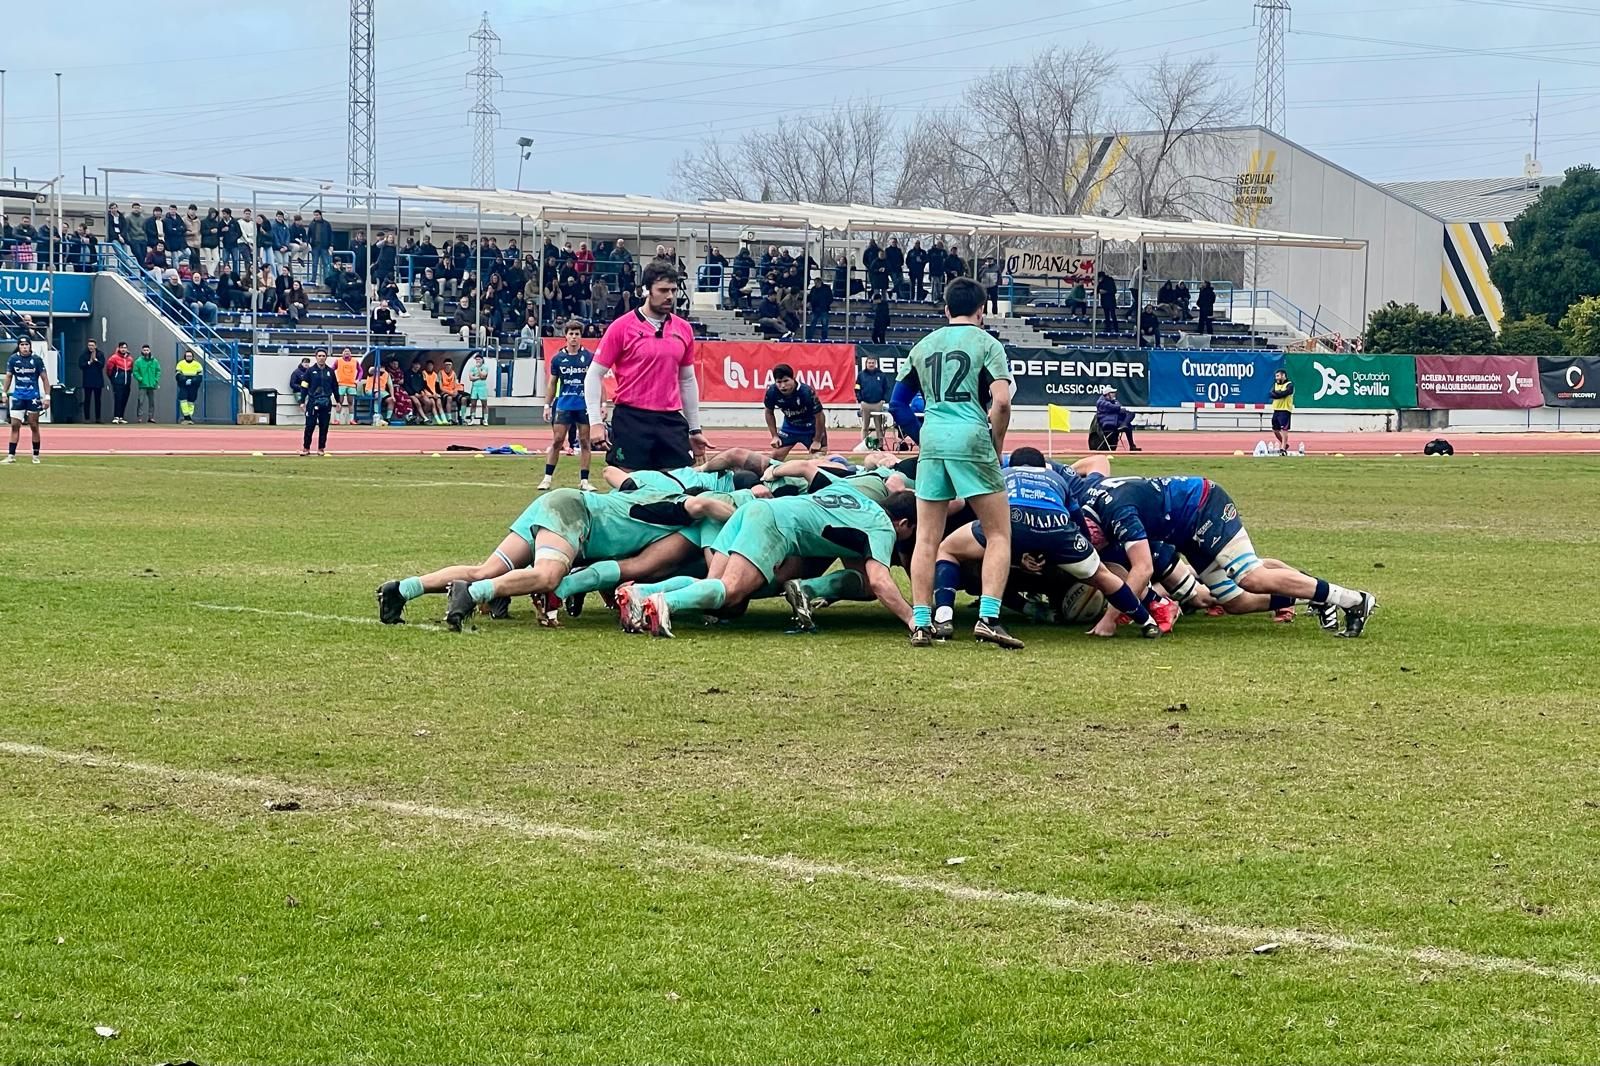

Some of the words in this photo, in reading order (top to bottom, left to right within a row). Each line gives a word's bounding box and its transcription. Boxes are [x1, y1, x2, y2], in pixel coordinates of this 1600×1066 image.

[1022, 253, 1080, 274] PIRAÑAS
[0, 276, 54, 293] TUJA
[925, 350, 971, 402] 12
[1010, 360, 1144, 377] DEFENDER
[1181, 357, 1255, 380] Cruzcampo
[1352, 371, 1390, 382] Diputación
[753, 369, 834, 390] LAANA
[1421, 374, 1446, 382] ACELERA
[1446, 374, 1455, 382] TU
[1455, 373, 1501, 382] RECUPERACIÓN
[1045, 384, 1084, 394] CLASSIC
[1353, 382, 1390, 396] Sevilla
[812, 494, 862, 510] 8
[1023, 511, 1069, 528] MAJAO
